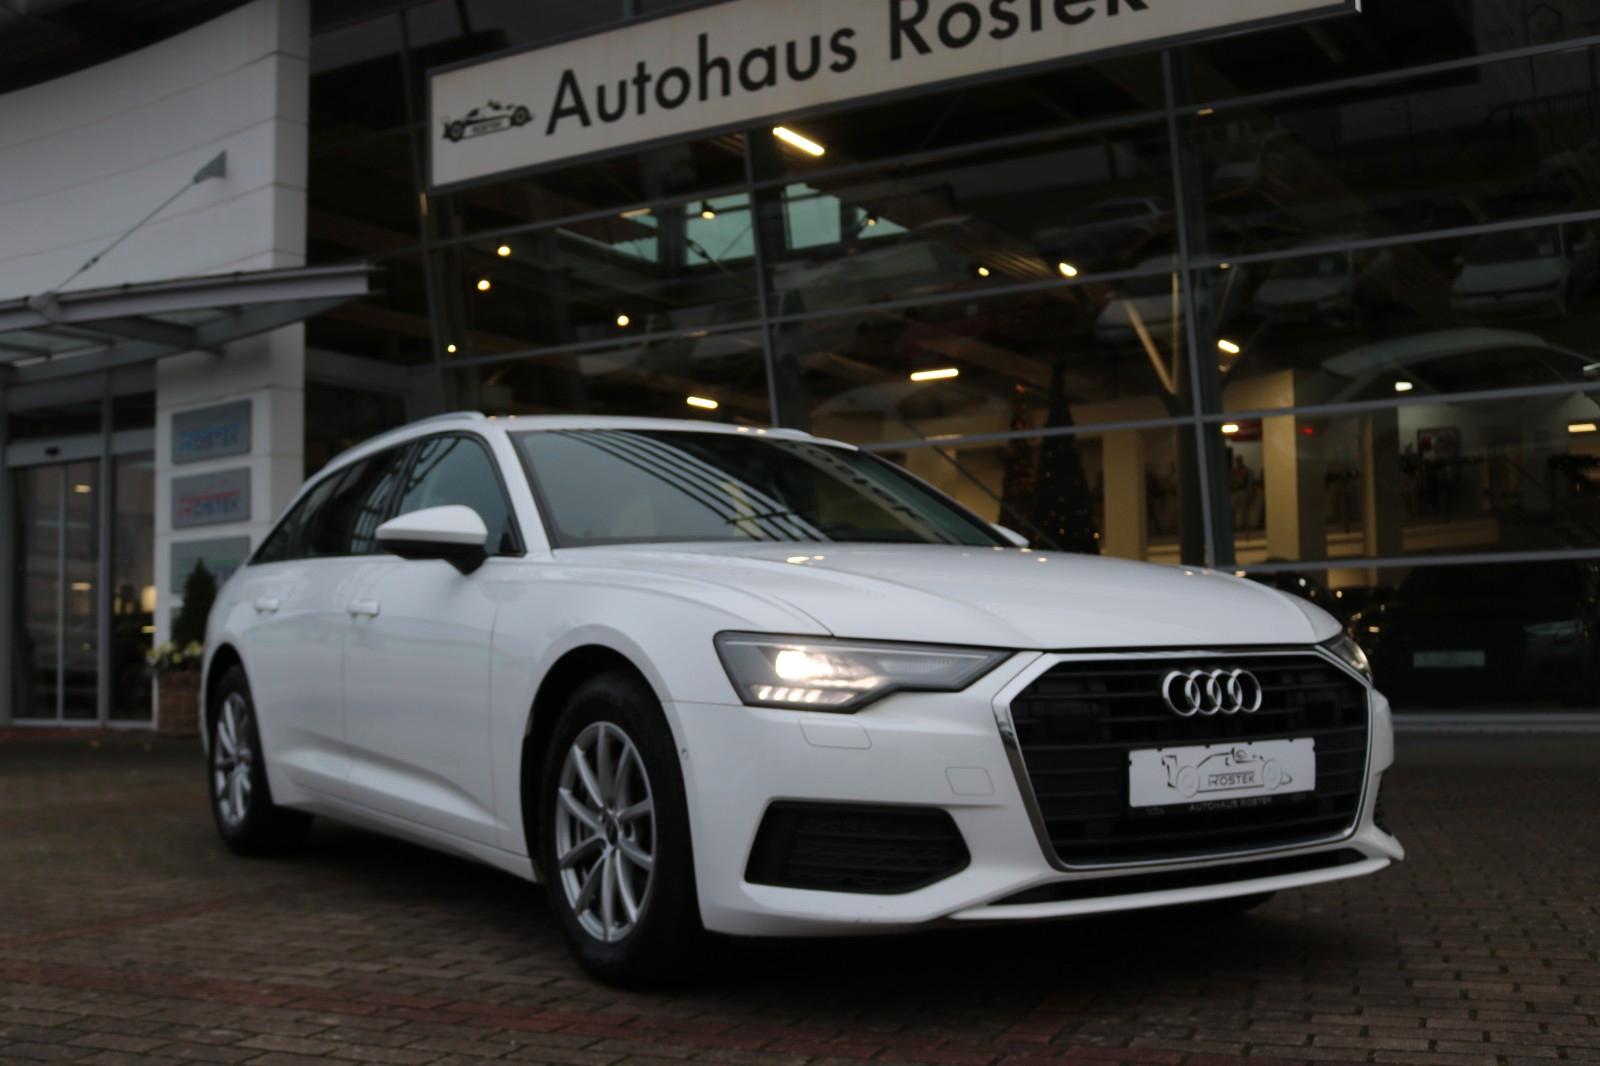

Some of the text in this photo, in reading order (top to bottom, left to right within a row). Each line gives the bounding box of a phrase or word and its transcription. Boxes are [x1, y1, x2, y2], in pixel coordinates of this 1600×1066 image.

[545, 0, 1149, 136] Autohaus Roste
[1208, 770, 1255, 787] ROSTEK
